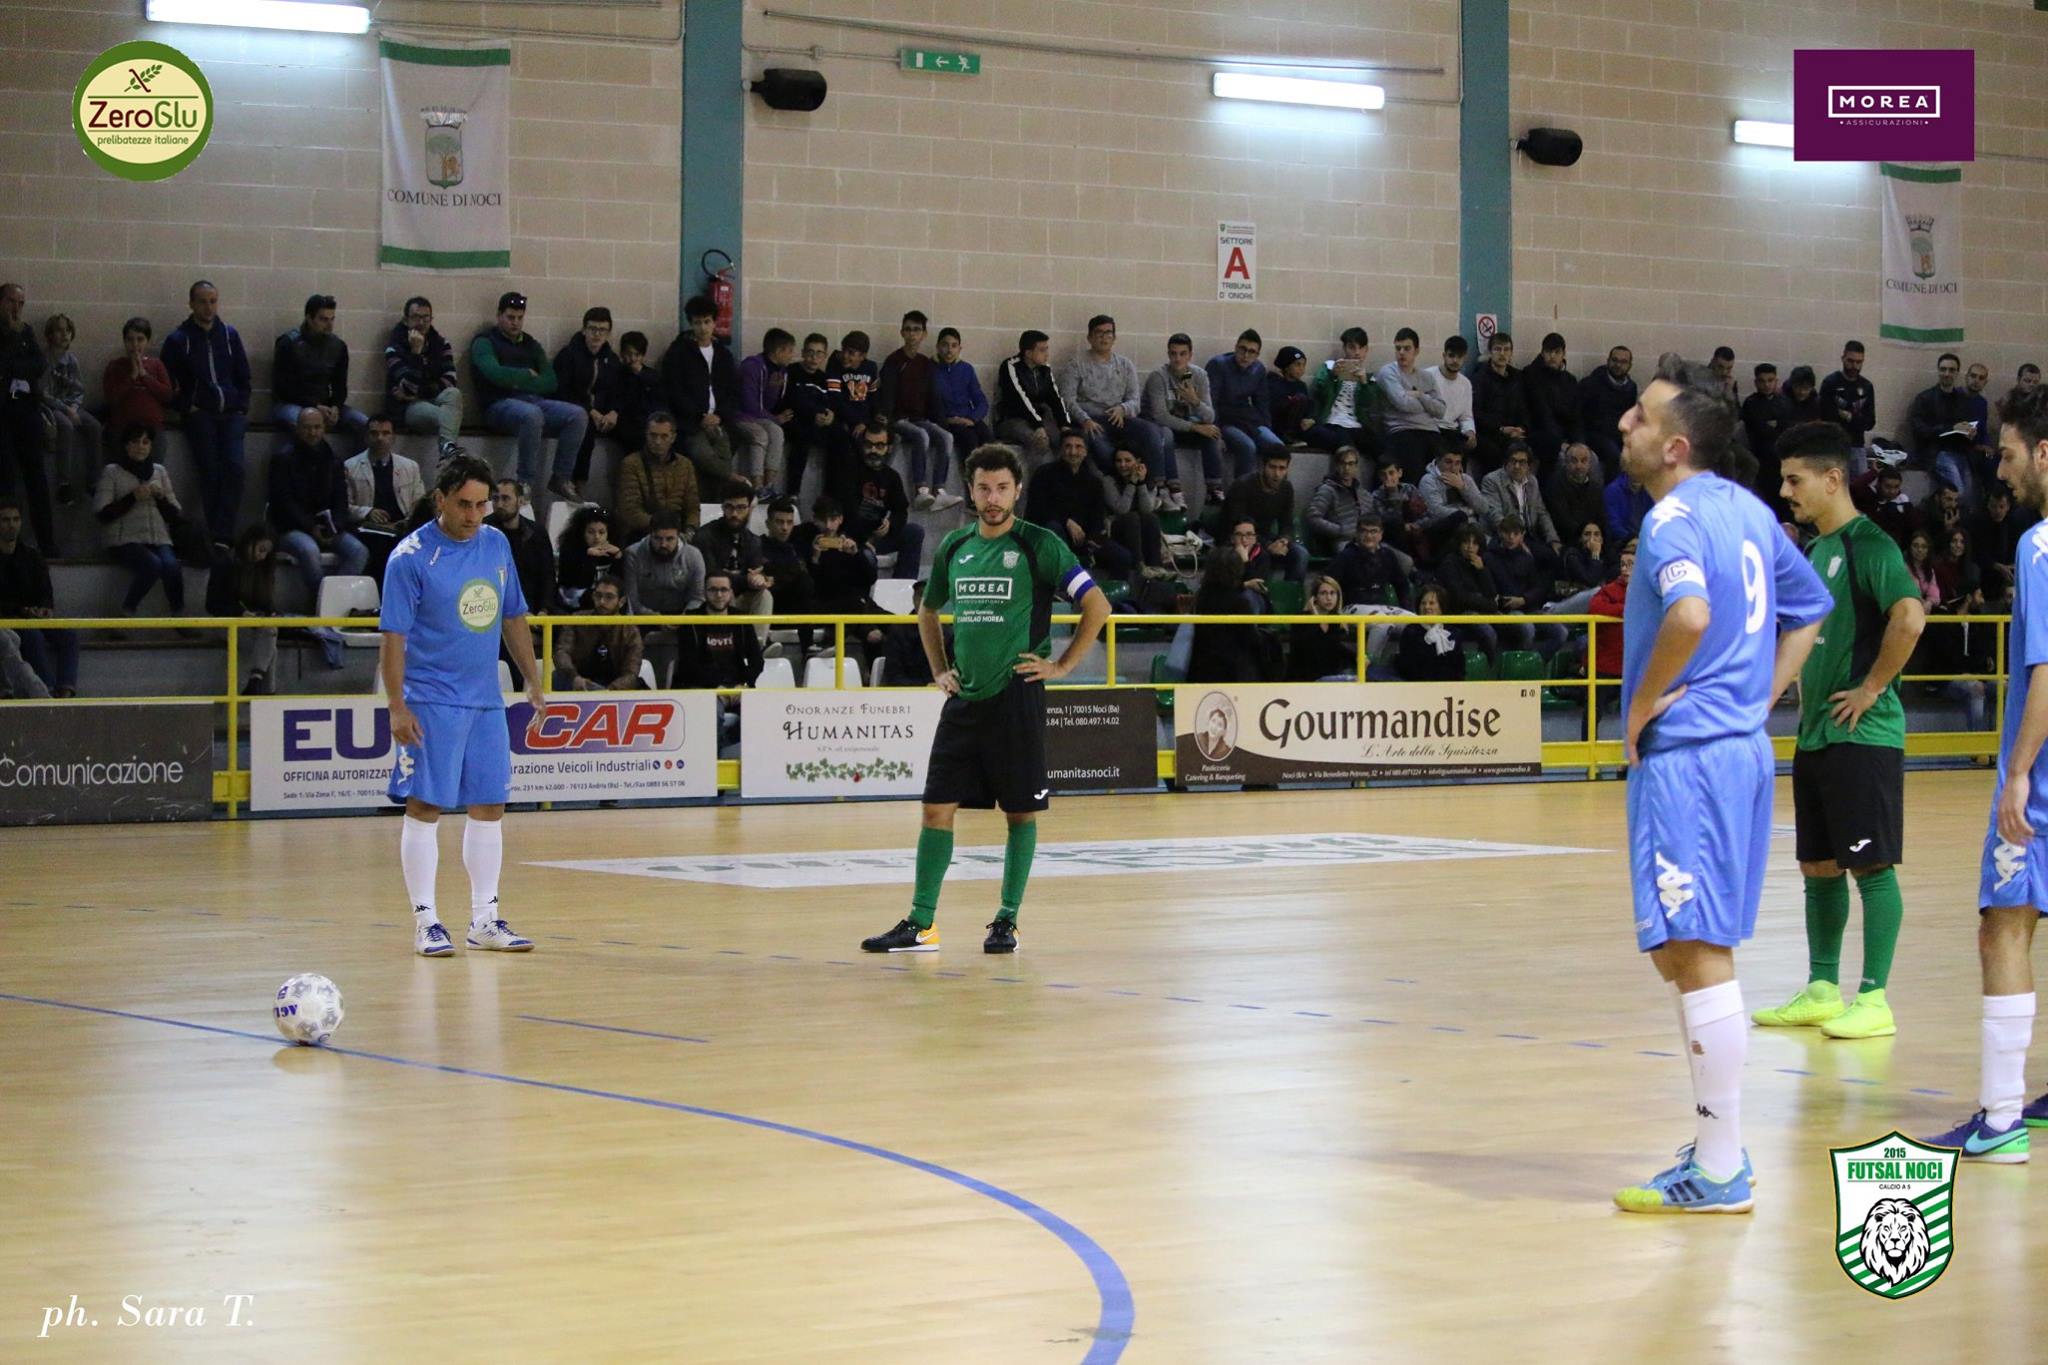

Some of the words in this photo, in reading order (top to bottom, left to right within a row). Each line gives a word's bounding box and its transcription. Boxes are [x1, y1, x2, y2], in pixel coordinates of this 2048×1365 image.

[386, 189, 449, 207] COMUNE
[452, 193, 467, 207] DI
[1223, 246, 1251, 280] A
[1665, 562, 1687, 583] C
[958, 584, 1005, 593] MOREA
[1742, 540, 1768, 635] 9
[1073, 705, 1092, 713] 70015
[1092, 705, 1107, 713] Noci
[283, 707, 392, 761] EU
[524, 703, 676, 750] CAR
[782, 721, 914, 740] HUMANITAS
[1258, 695, 1502, 749] Gourmandise
[0, 754, 184, 787] Comunicazione
[283, 770, 329, 782] OFFICINA
[332, 768, 392, 781] AUTORIZZAT
[557, 760, 593, 774] Veicoli
[596, 759, 651, 773] Industriali
[1047, 766, 1120, 779] umanitasnoci.it
